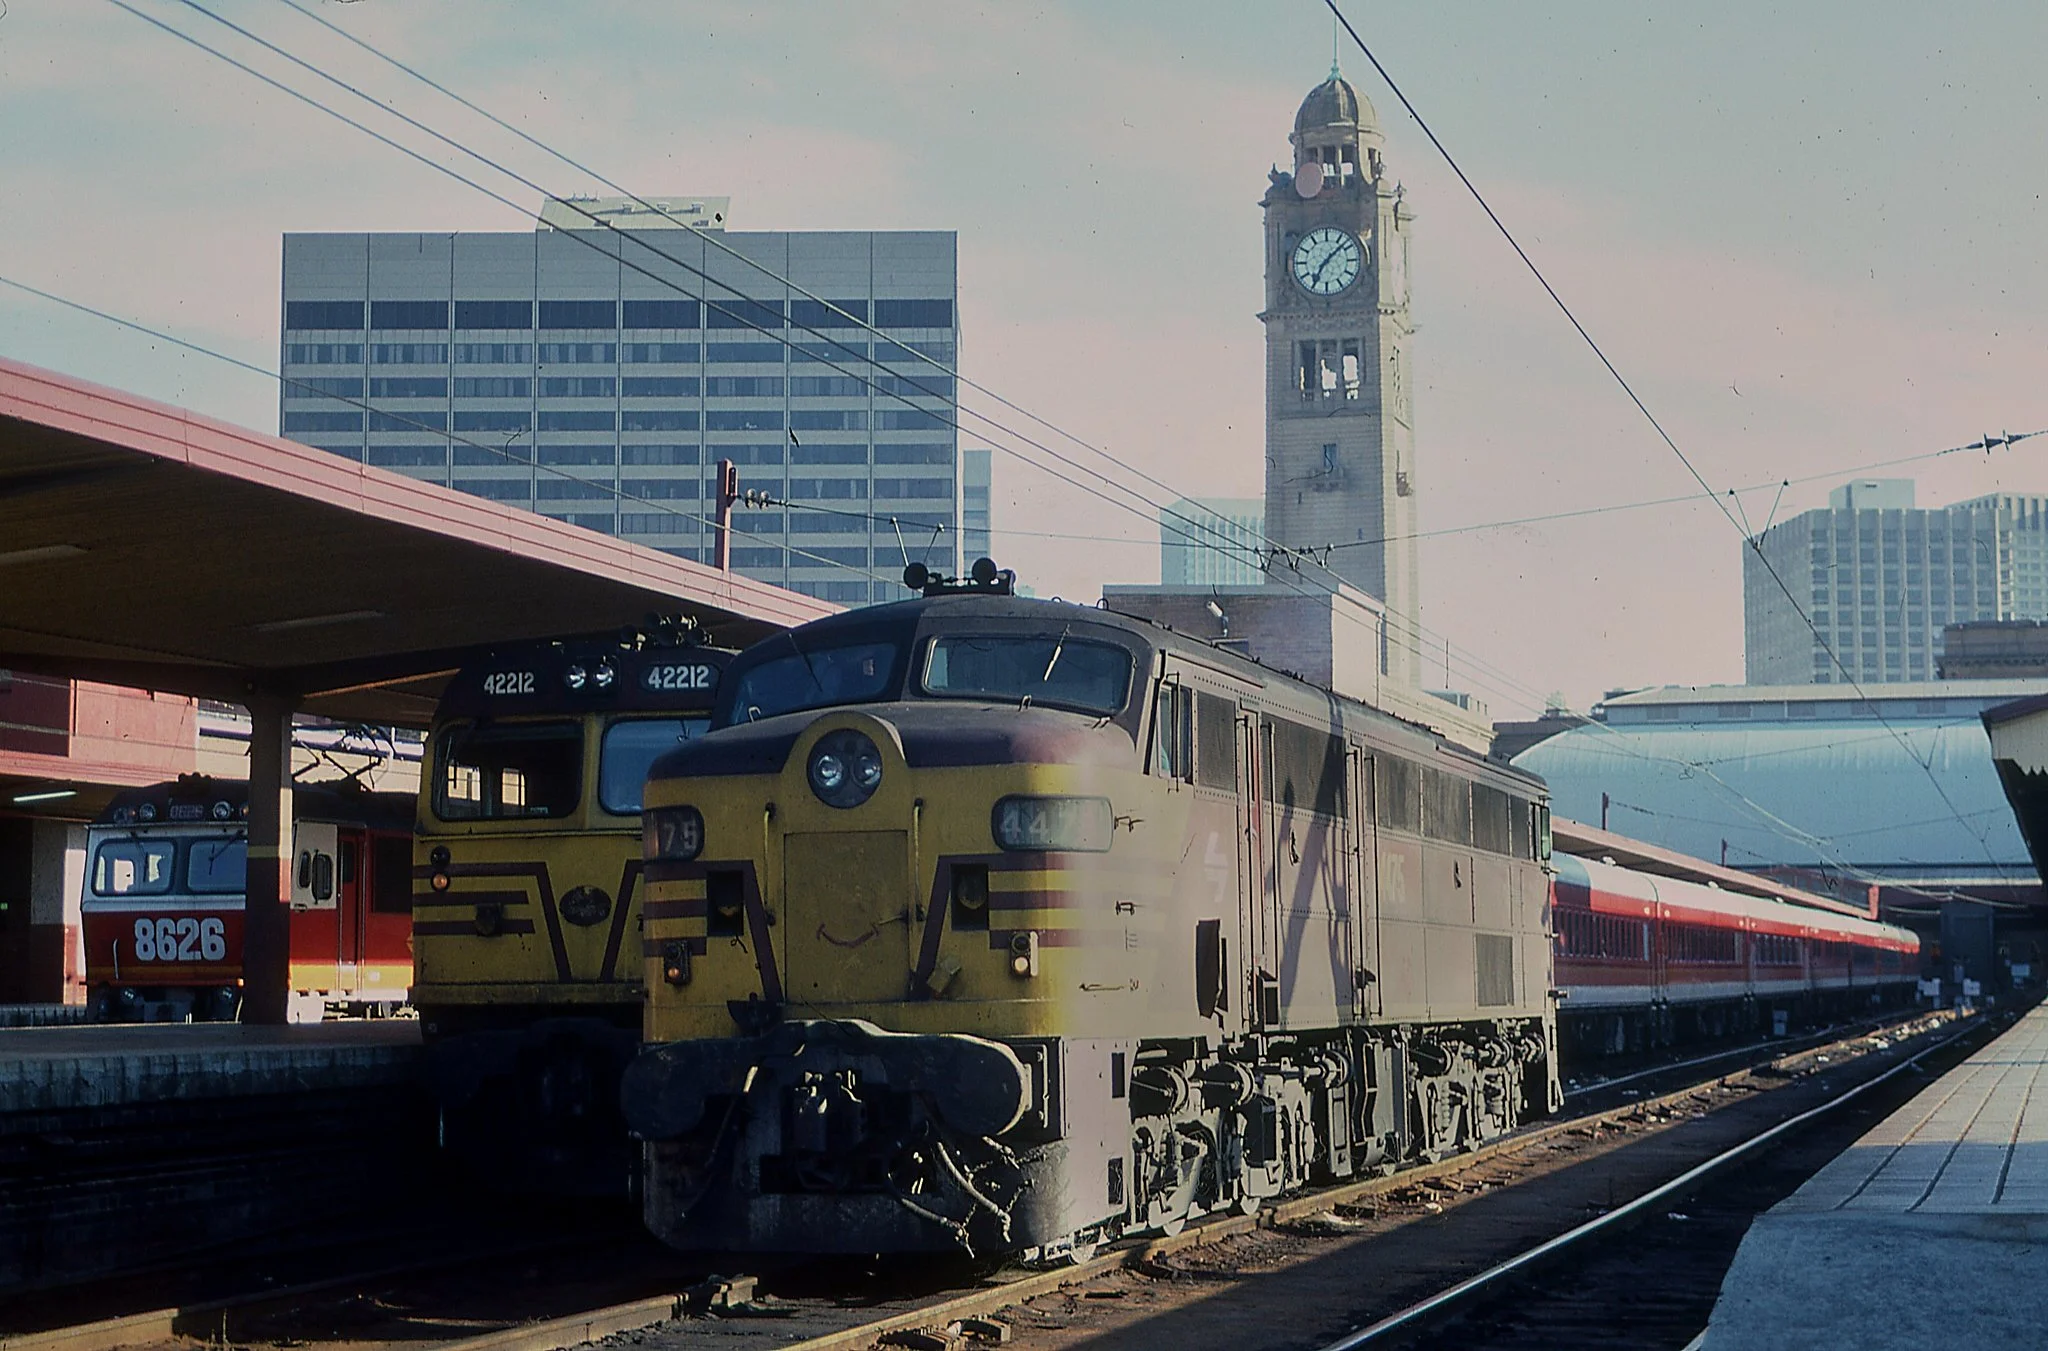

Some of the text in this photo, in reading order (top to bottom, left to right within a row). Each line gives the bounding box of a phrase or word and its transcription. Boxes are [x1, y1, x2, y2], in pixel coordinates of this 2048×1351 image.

[484, 672, 535, 694] 42212
[648, 665, 710, 689] 42212
[134, 918, 225, 961] 8626
